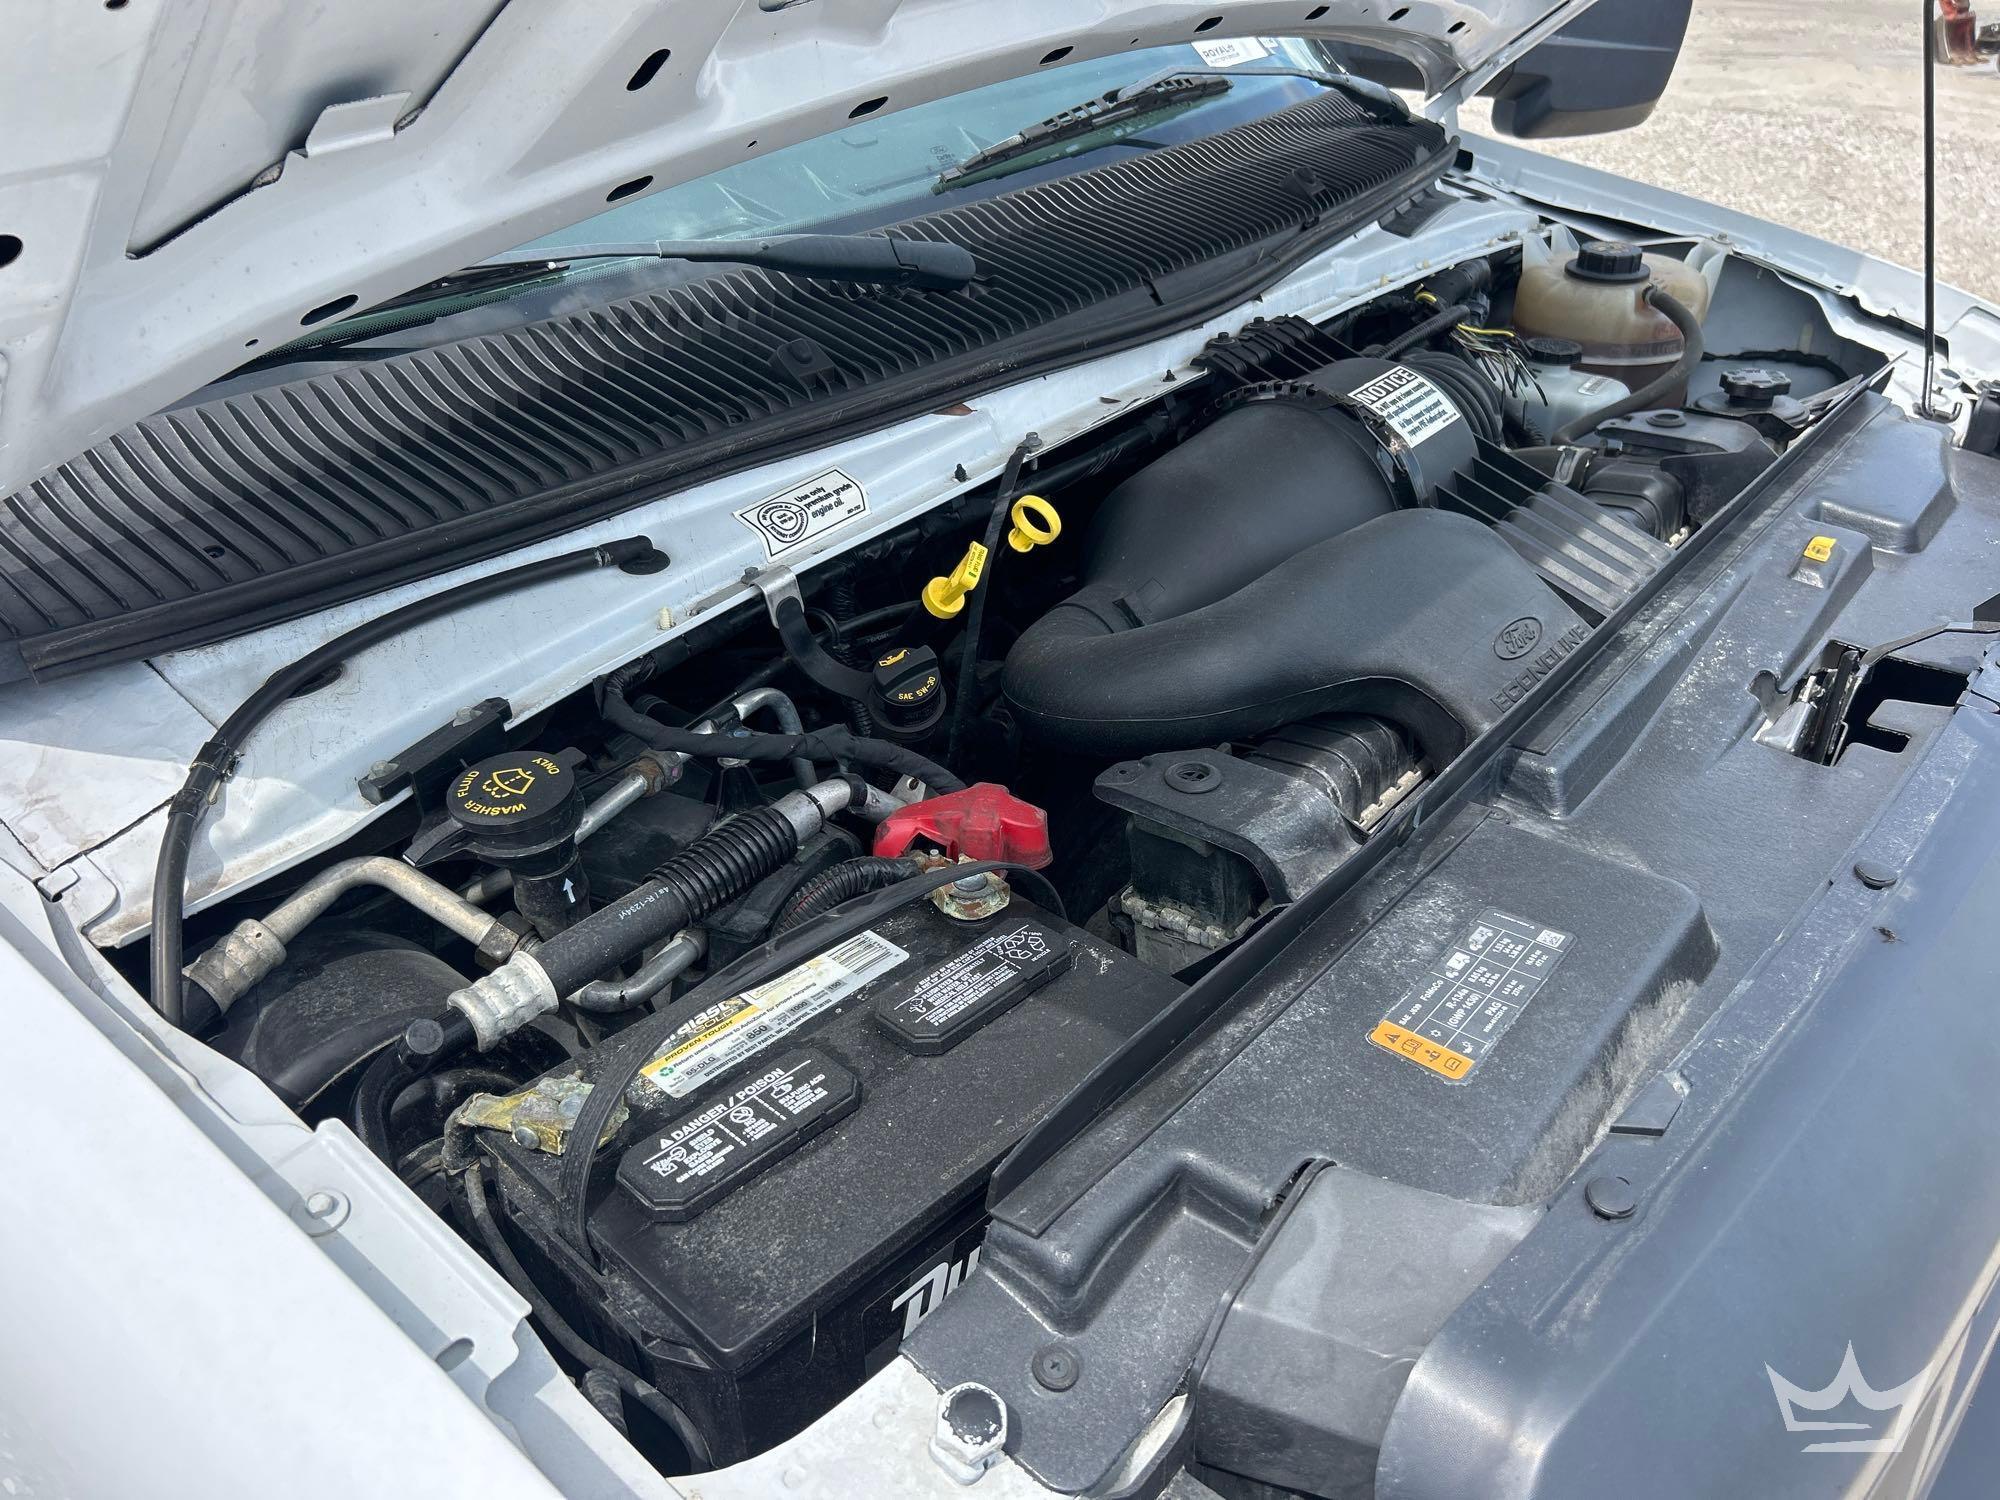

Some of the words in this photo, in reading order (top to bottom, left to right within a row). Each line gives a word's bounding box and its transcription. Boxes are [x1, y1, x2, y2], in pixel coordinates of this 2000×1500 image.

[1203, 45, 1228, 58] ROYAL
[1356, 369, 1417, 404] NOTICE
[794, 494, 810, 502] Use
[809, 486, 826, 496] only
[803, 492, 834, 510] premium
[832, 483, 852, 496] grade
[811, 503, 833, 518] engine
[833, 497, 844, 507] oil.
[1501, 623, 1536, 654] Ford
[916, 676, 936, 697] 5W-30
[531, 757, 560, 775] ONLY
[457, 770, 480, 798] FLUID
[464, 800, 527, 816] WASHER
[828, 981, 841, 990] 150
[1420, 979, 1443, 1001] FoMoCo
[790, 1001, 807, 1012] 1000
[1445, 988, 1468, 1009] R-134a
[1484, 1001, 1502, 1016] PAG
[1447, 1008, 1465, 1027] (GWP
[1462, 993, 1482, 1009] 1430)
[665, 1038, 701, 1061] PROVEN
[702, 1020, 732, 1038] TOUGH
[673, 1054, 694, 1068] Return
[740, 1012, 766, 1029] AutoZone
[746, 1025, 767, 1039] 850
[686, 1056, 716, 1075] 65-DLG
[671, 1104, 729, 1140] DANGER
[736, 1068, 787, 1100] POISON
